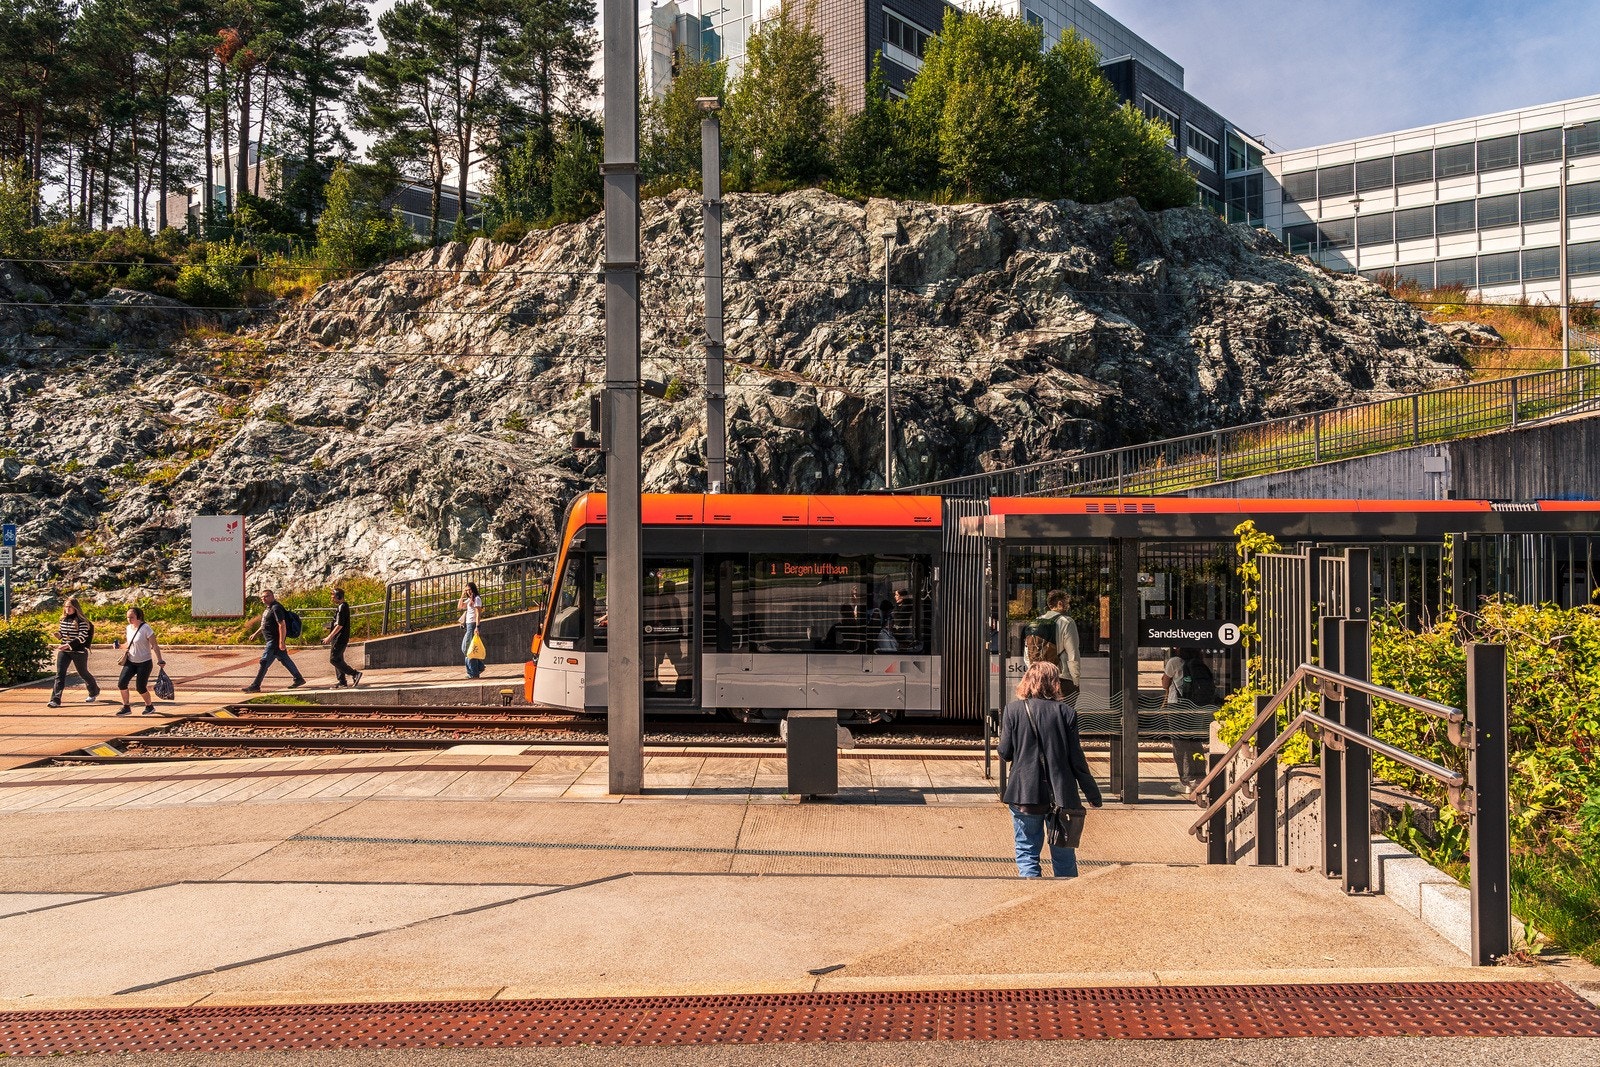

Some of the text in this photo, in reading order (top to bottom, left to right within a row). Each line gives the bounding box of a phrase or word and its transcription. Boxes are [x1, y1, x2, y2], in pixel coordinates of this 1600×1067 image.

[770, 563, 777, 575] 1
[784, 562, 813, 577] Bergen
[1148, 628, 1235, 641] Sandslivegen B
[553, 656, 565, 665] 217
